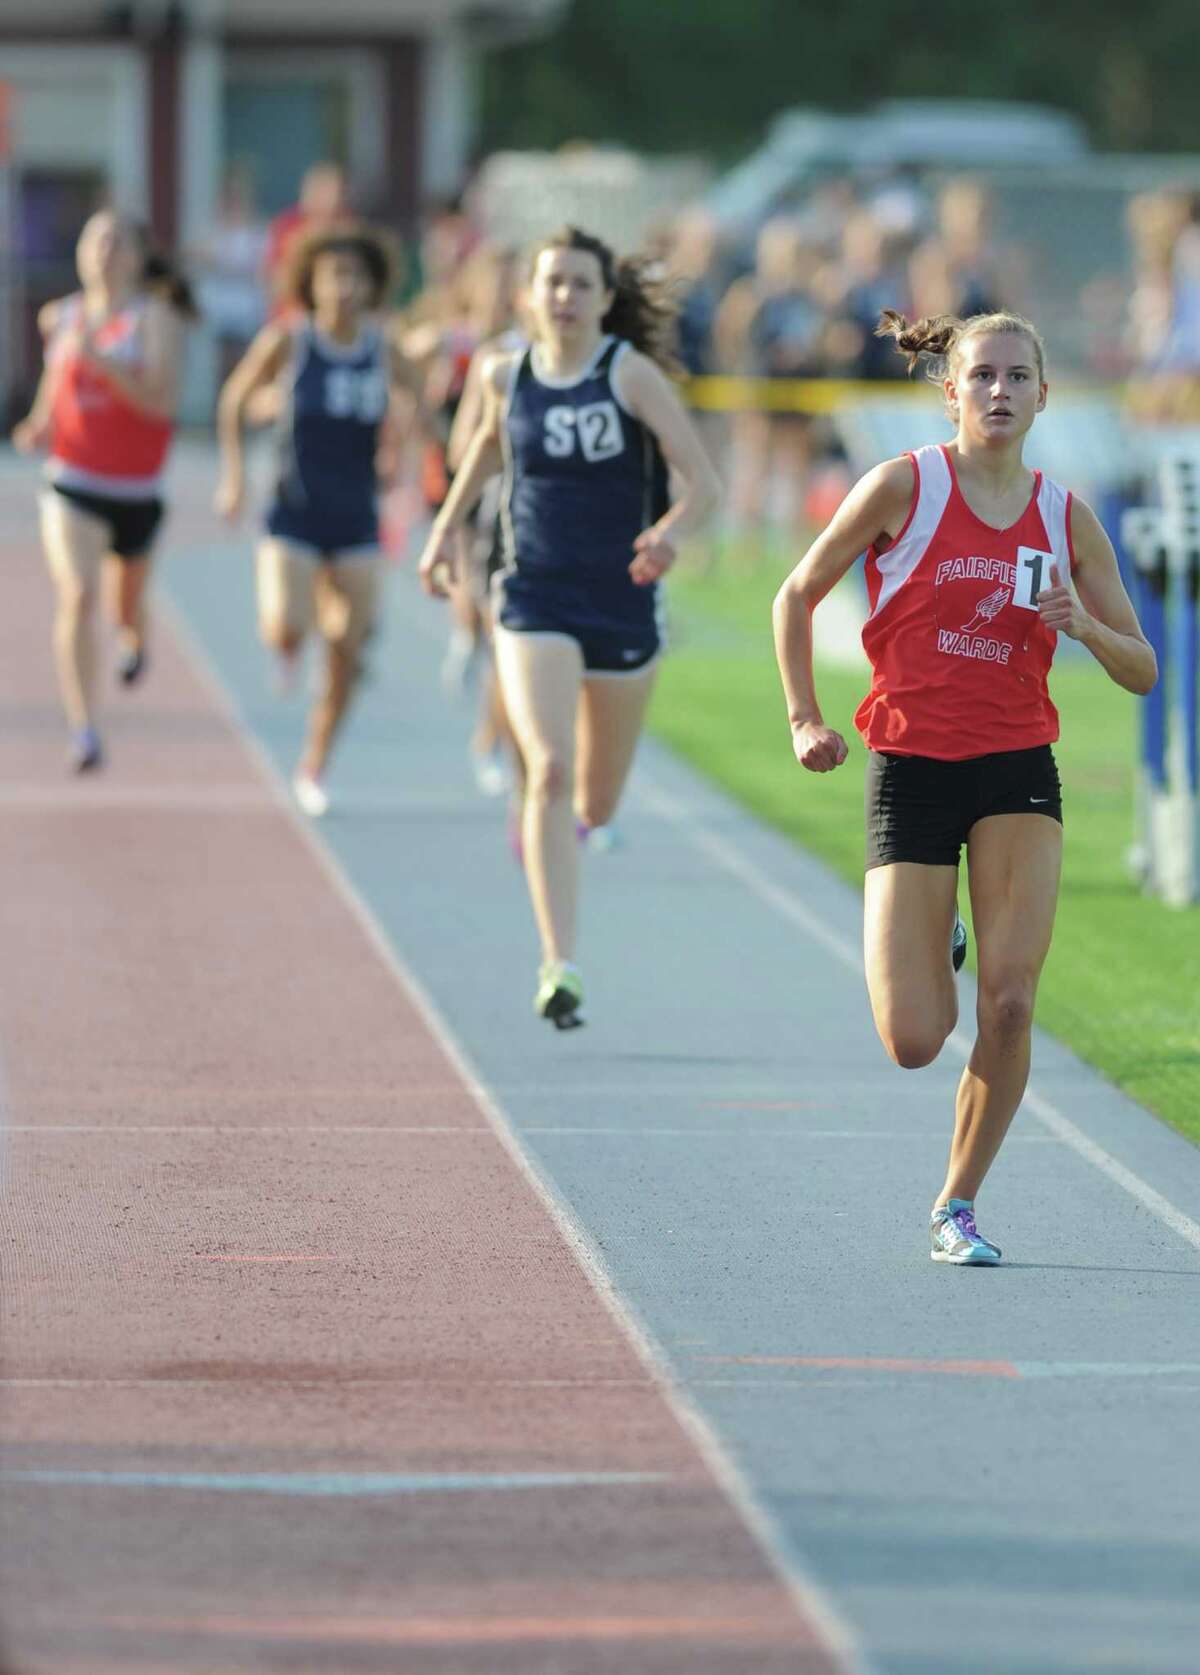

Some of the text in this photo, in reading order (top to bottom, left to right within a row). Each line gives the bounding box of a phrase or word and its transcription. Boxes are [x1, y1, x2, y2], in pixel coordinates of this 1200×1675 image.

[543, 404, 576, 458] S
[585, 409, 616, 454] 2
[1023, 554, 1044, 607] 1
[937, 628, 1013, 665] WARDE
